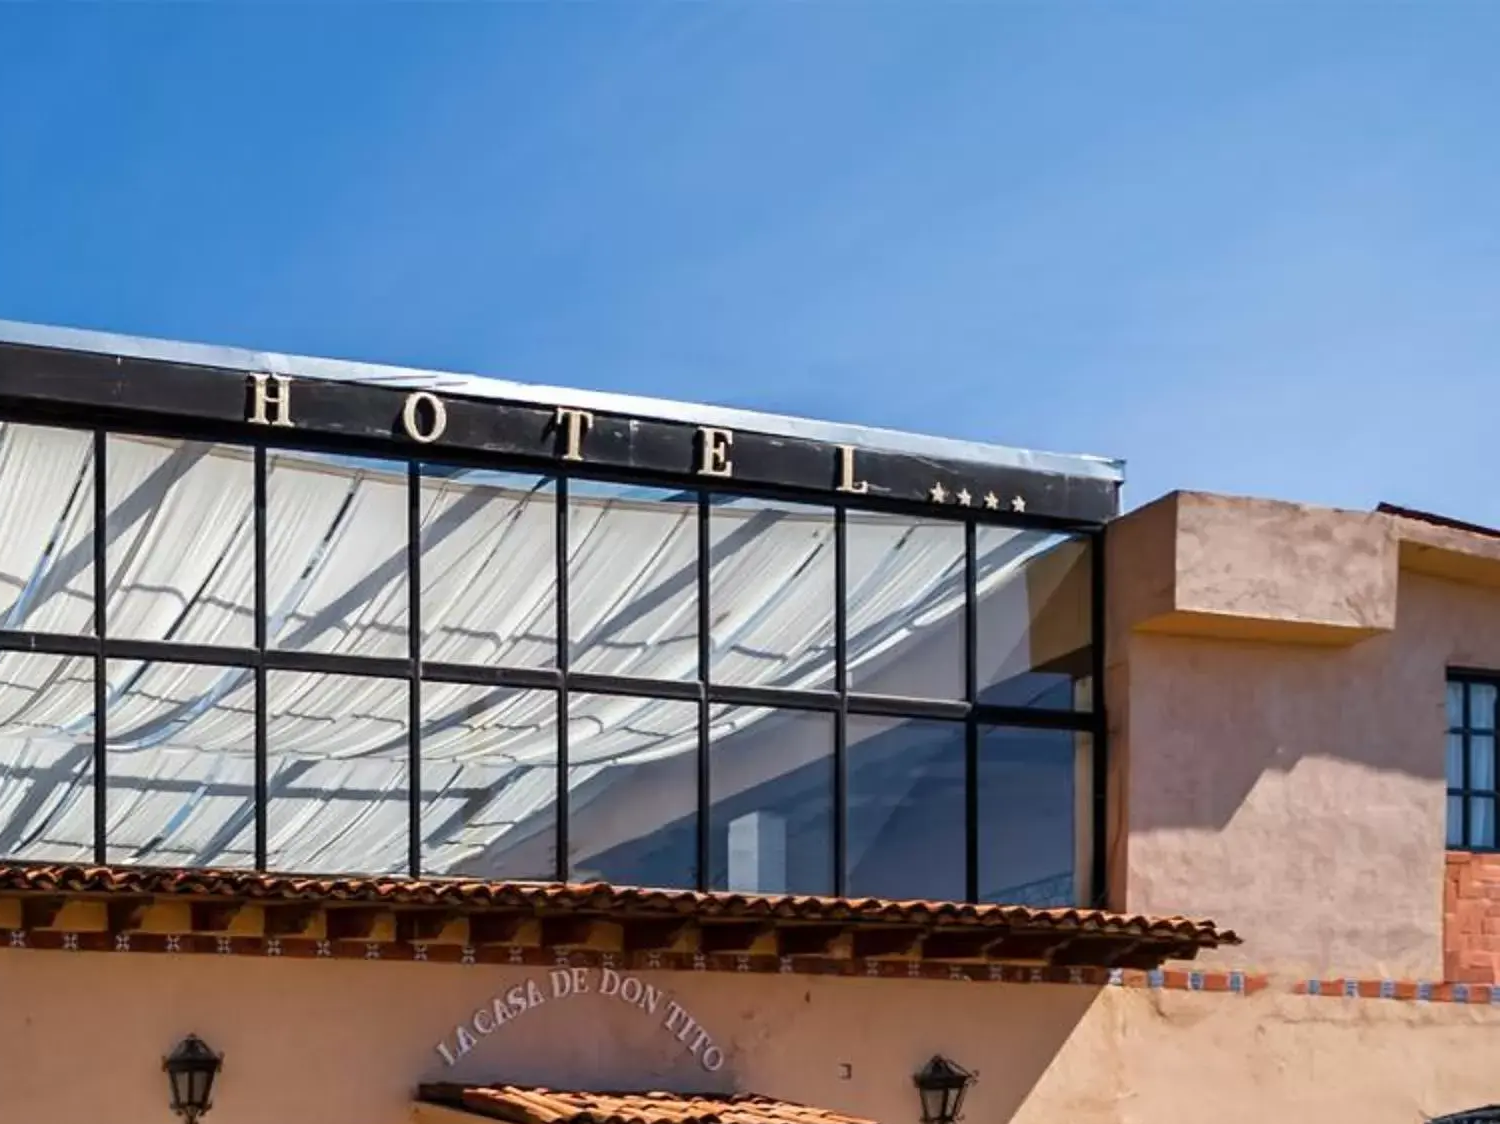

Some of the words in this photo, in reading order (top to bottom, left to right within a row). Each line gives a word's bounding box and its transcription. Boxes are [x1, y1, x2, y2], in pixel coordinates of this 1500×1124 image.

[247, 373, 869, 493] HOTEL
[436, 1025, 478, 1066] LA
[473, 979, 546, 1033] CASA
[550, 967, 590, 998] DE
[599, 967, 662, 1014] DON
[664, 1001, 724, 1071] TITO
